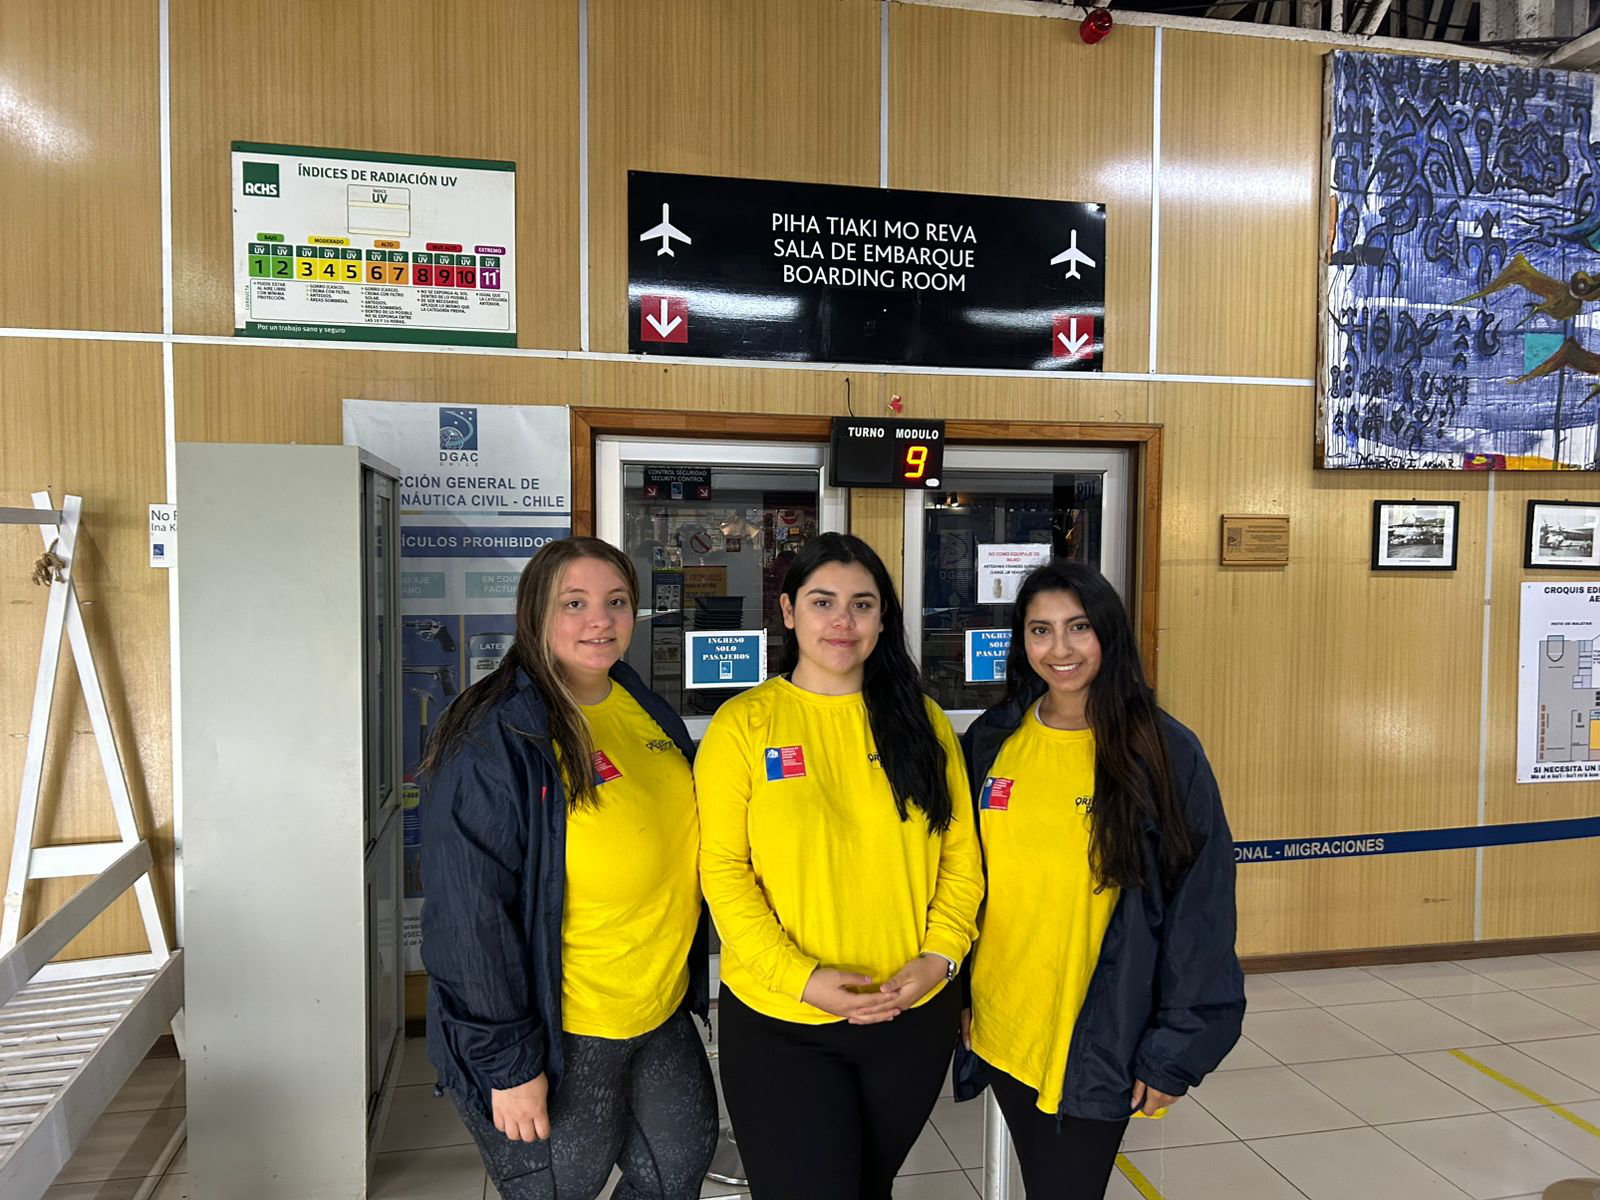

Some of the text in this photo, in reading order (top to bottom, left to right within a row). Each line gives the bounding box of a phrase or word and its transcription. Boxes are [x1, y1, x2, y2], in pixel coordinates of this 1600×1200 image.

[298, 163, 458, 187] ÍNDICES DE RADIACIÓN UV
[245, 182, 278, 196] ACHS
[372, 193, 388, 203] UV
[772, 212, 977, 244] PIHA TIAKI MO REVA
[774, 238, 975, 270] SALA DE EMBARQUE
[255, 260, 262, 274] 1
[277, 261, 288, 275] 2
[302, 262, 313, 276] 3
[323, 264, 335, 277] 4
[346, 265, 357, 279] 5
[371, 266, 382, 280] 6
[393, 267, 404, 281] 7
[417, 268, 429, 283] 8
[439, 269, 450, 283] 9
[458, 270, 475, 284] 10
[784, 265, 966, 292] BOARDING ROOM
[848, 427, 939, 440] TURNO MODULO
[440, 452, 478, 462] DGAC
[904, 446, 928, 478] 9
[446, 477, 516, 489] GENERAL
[521, 478, 539, 490] DE
[471, 495, 508, 506] CIVIL
[522, 496, 564, 507] CHILE
[152, 510, 170, 521] No
[1544, 587, 1584, 595] CROQUIS
[1284, 838, 1384, 857] MIGRACIONES
